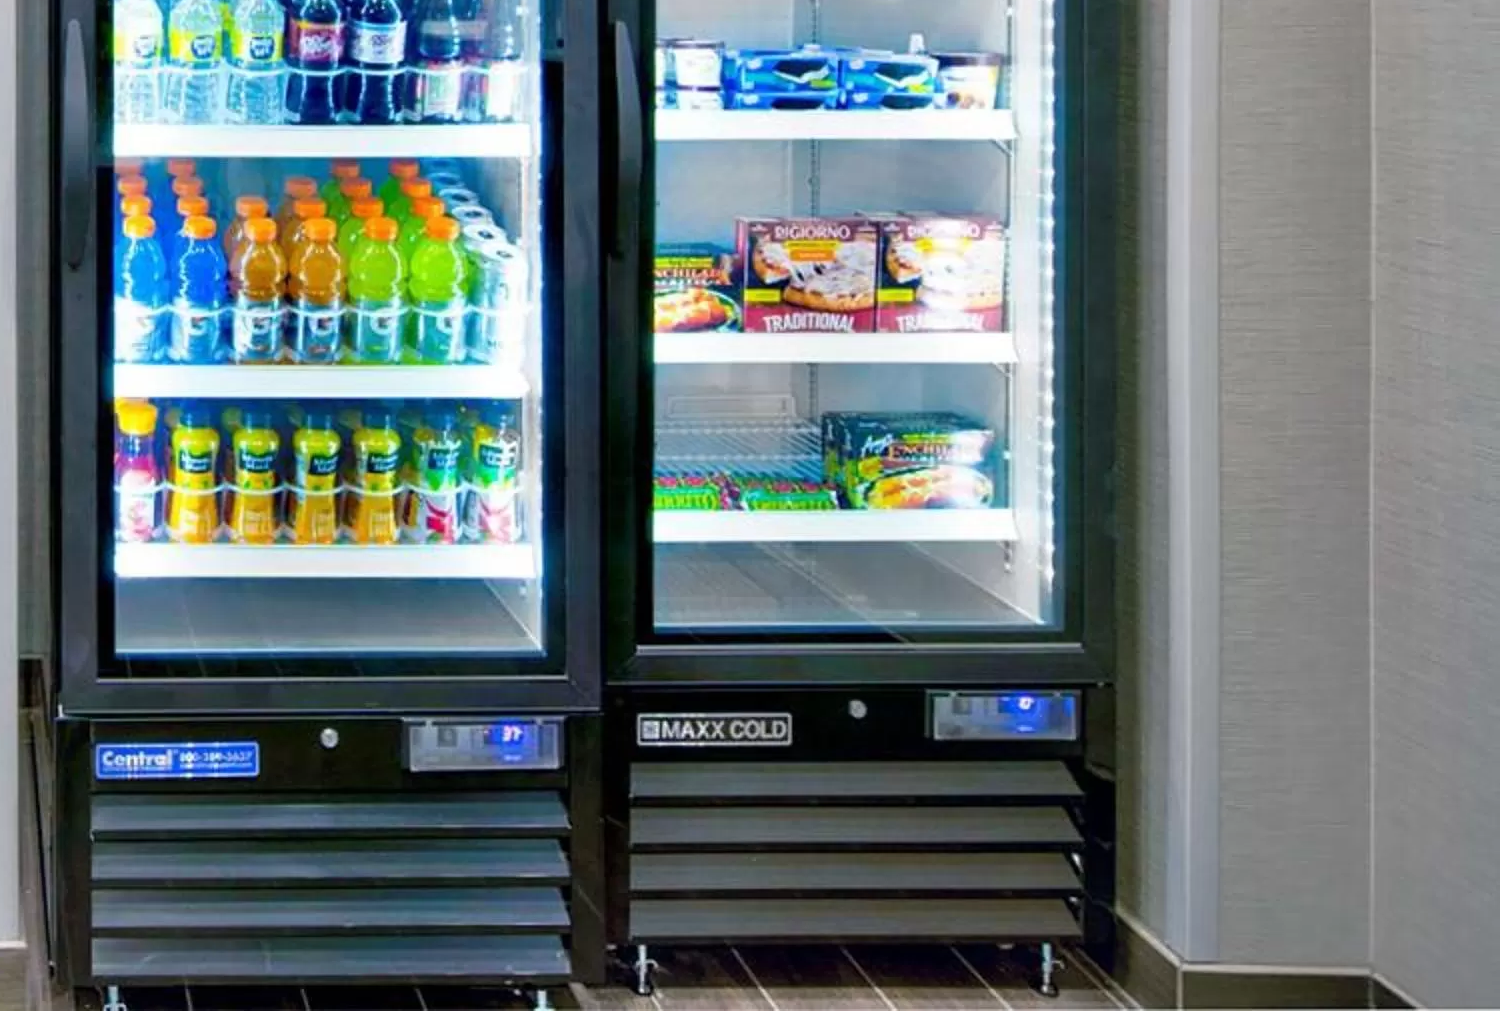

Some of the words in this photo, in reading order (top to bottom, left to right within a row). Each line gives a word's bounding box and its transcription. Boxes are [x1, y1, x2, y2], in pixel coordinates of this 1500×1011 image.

[762, 311, 856, 332] TRADITIONAL
[661, 720, 725, 739] MAXX
[729, 720, 787, 739] COLD
[102, 749, 172, 767] Central
